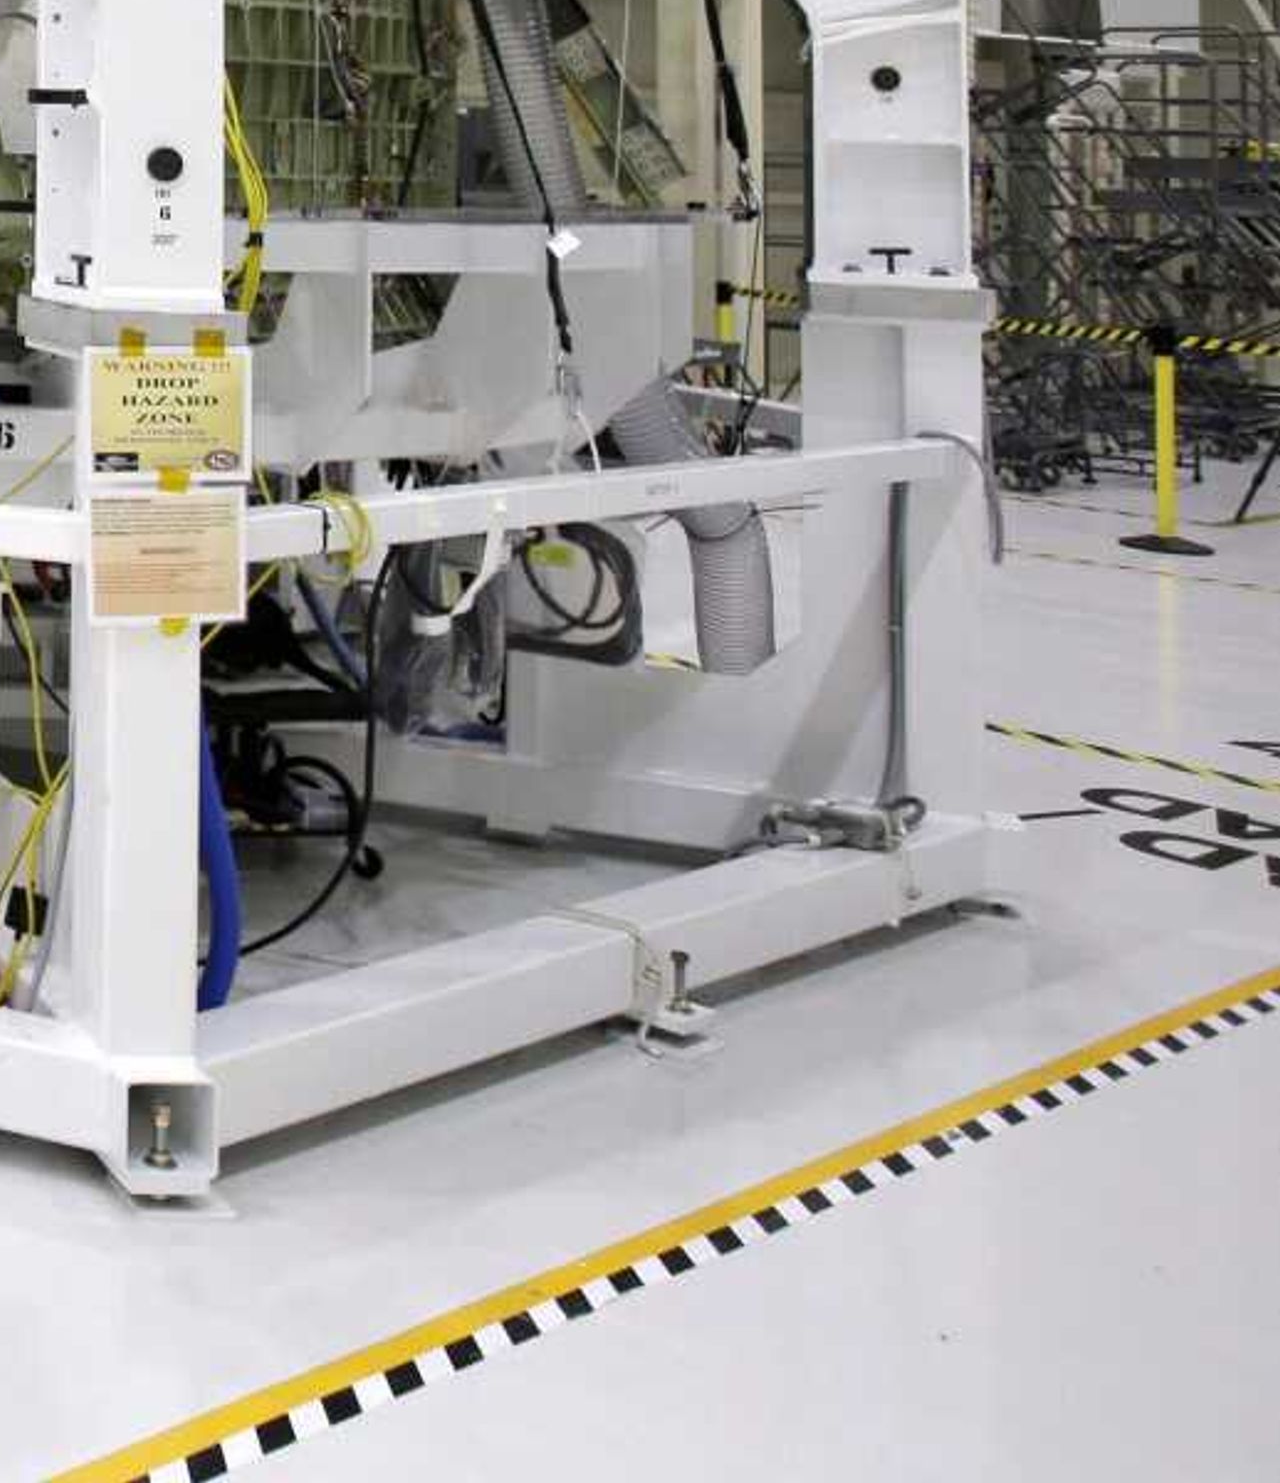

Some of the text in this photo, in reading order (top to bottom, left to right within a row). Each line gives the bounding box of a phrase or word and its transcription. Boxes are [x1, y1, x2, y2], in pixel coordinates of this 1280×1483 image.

[136, 377, 201, 389] DROP
[121, 395, 220, 407] HAZARD
[135, 412, 196, 425] ZONE
